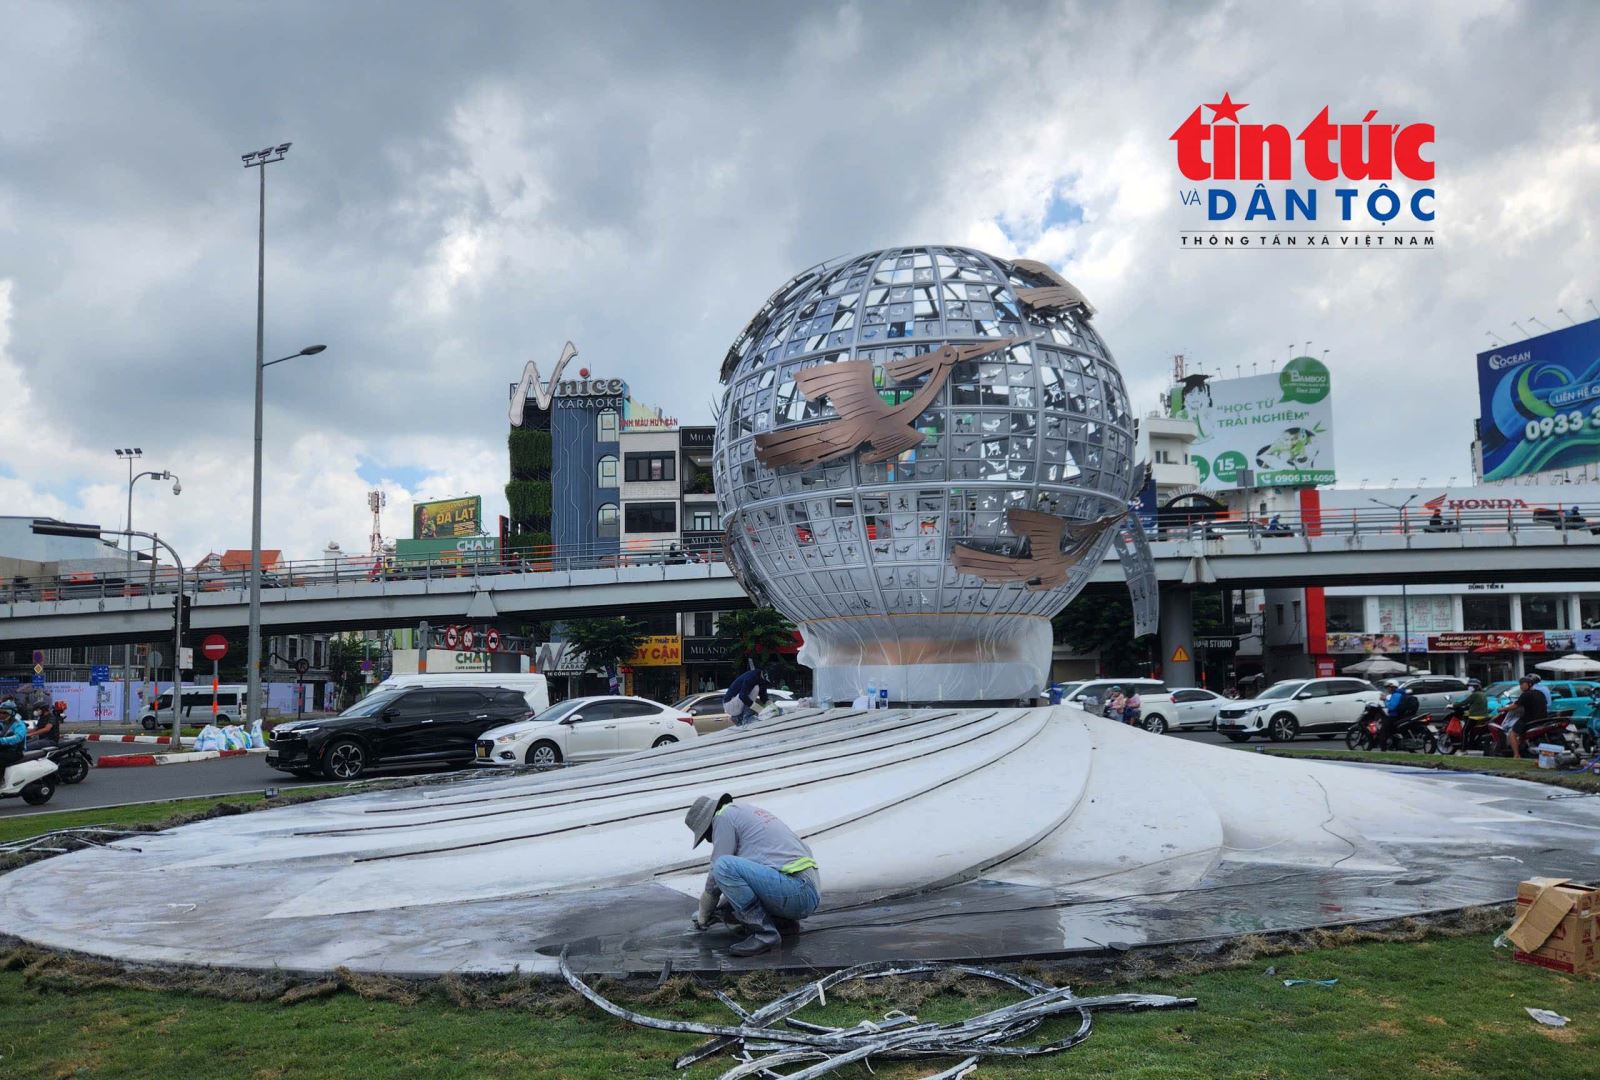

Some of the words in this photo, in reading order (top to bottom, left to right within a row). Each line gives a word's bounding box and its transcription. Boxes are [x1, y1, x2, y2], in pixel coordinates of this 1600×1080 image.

[1499, 351, 1531, 368] OCEAN
[558, 370, 624, 398] nice
[1555, 391, 1575, 403] LIÊN
[1577, 386, 1590, 399] HỆ
[557, 398, 624, 409] KARAOKE
[1216, 415, 1248, 428] TRẢI
[1525, 410, 1584, 441] 0933
[1217, 458, 1236, 472] 15
[1448, 499, 1529, 510] HONDA
[1209, 640, 1232, 648] STUDIO
[652, 645, 679, 662] CẬN
